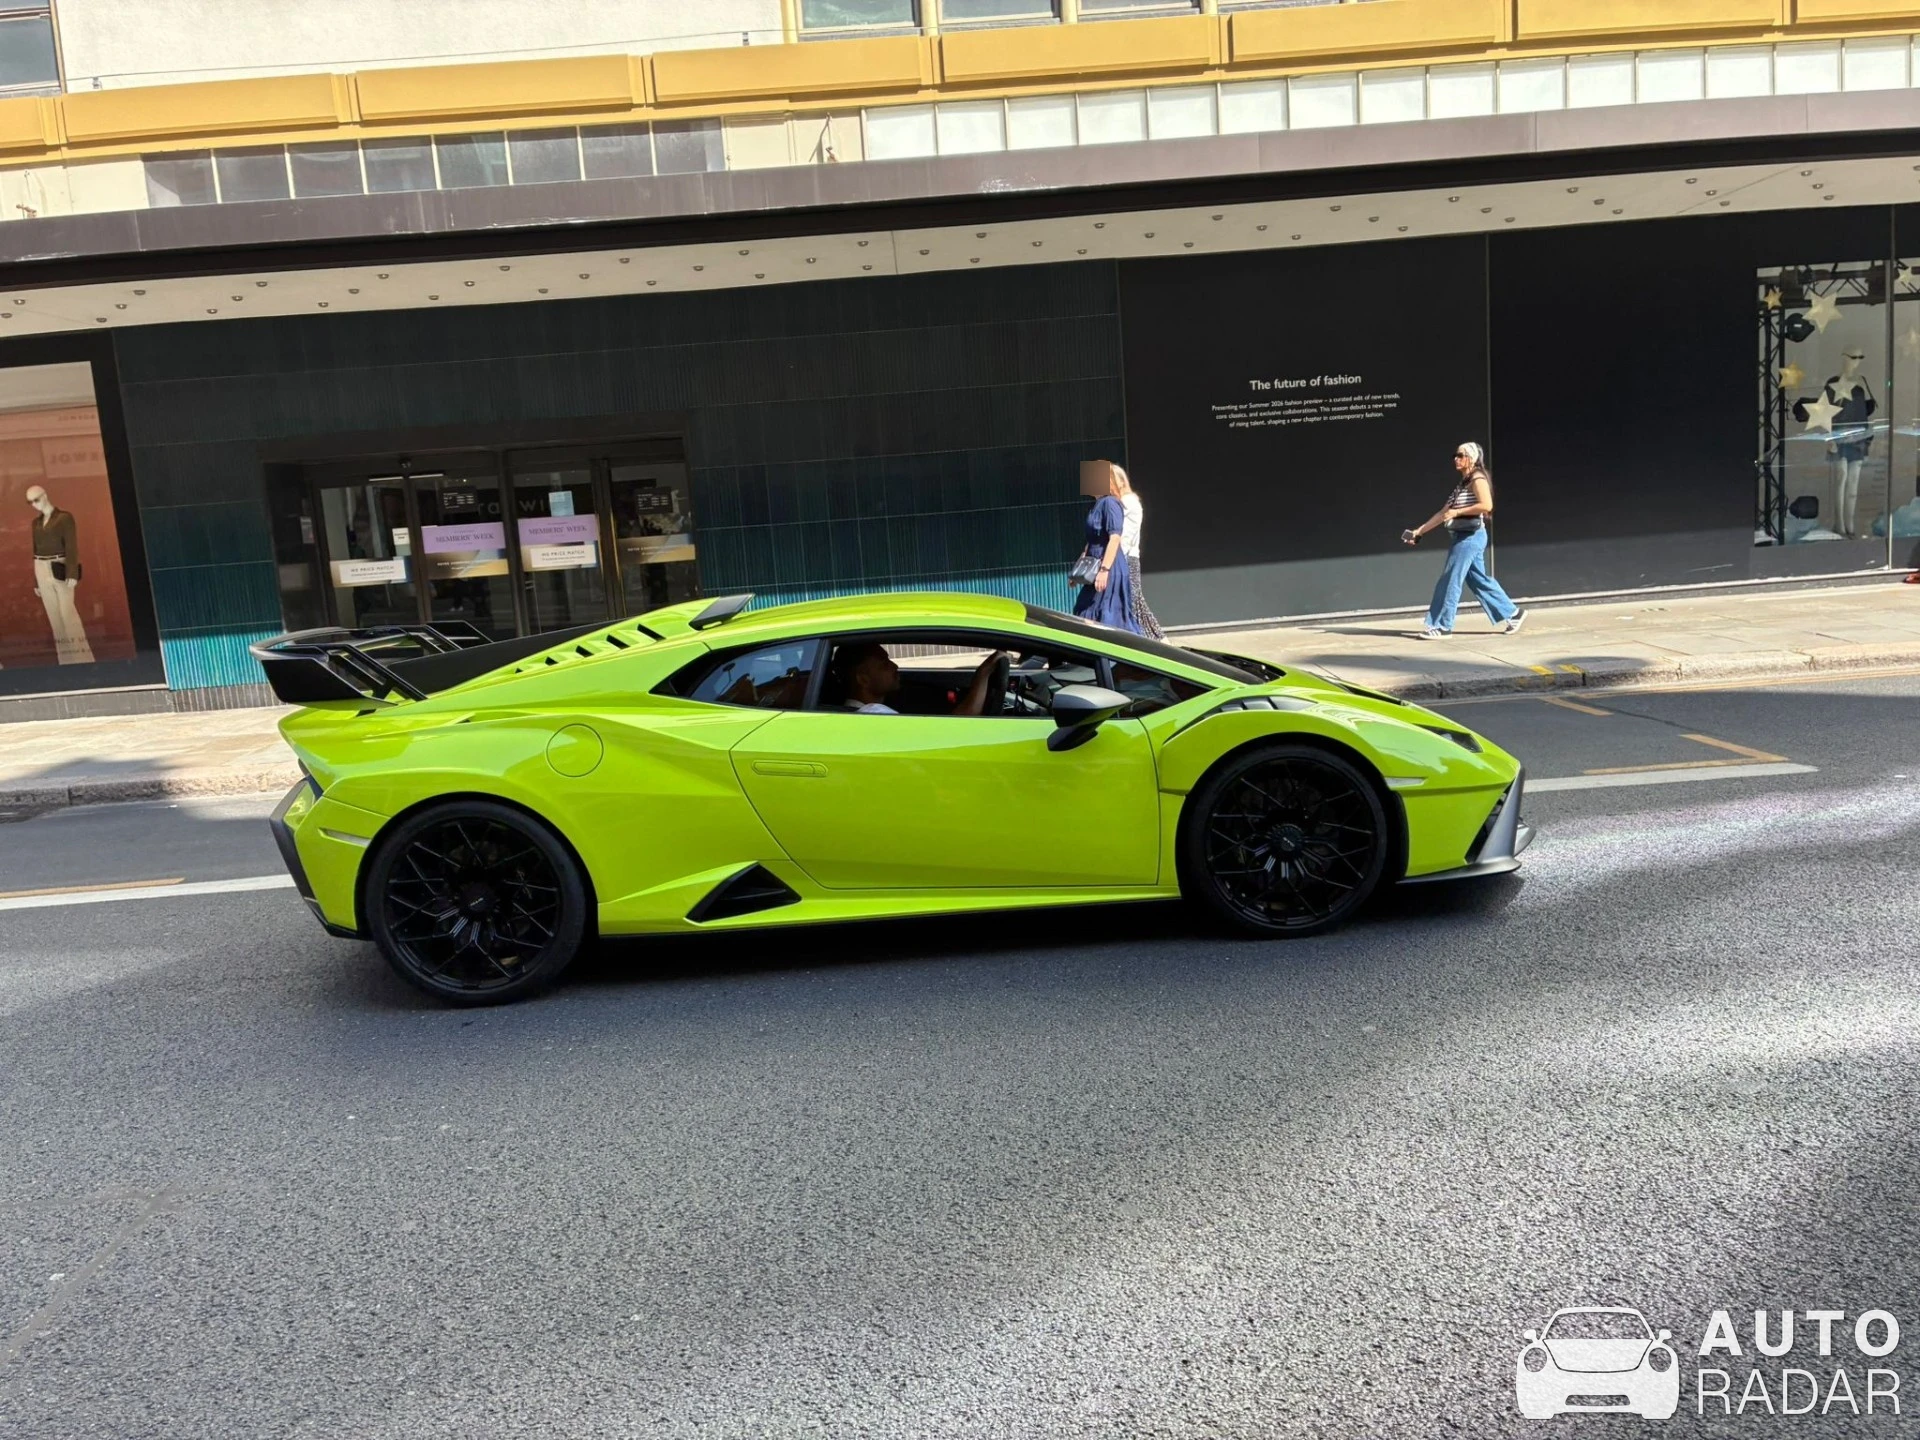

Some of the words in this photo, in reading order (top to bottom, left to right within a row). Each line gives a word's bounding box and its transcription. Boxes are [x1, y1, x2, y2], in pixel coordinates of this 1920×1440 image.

[1249, 380, 1271, 391] The
[1274, 378, 1306, 389] future
[1310, 376, 1322, 387] of
[1323, 374, 1362, 386] fashion
[1303, 398, 1323, 406] preview
[567, 524, 588, 533] WEEK
[473, 532, 495, 541] WEEK
